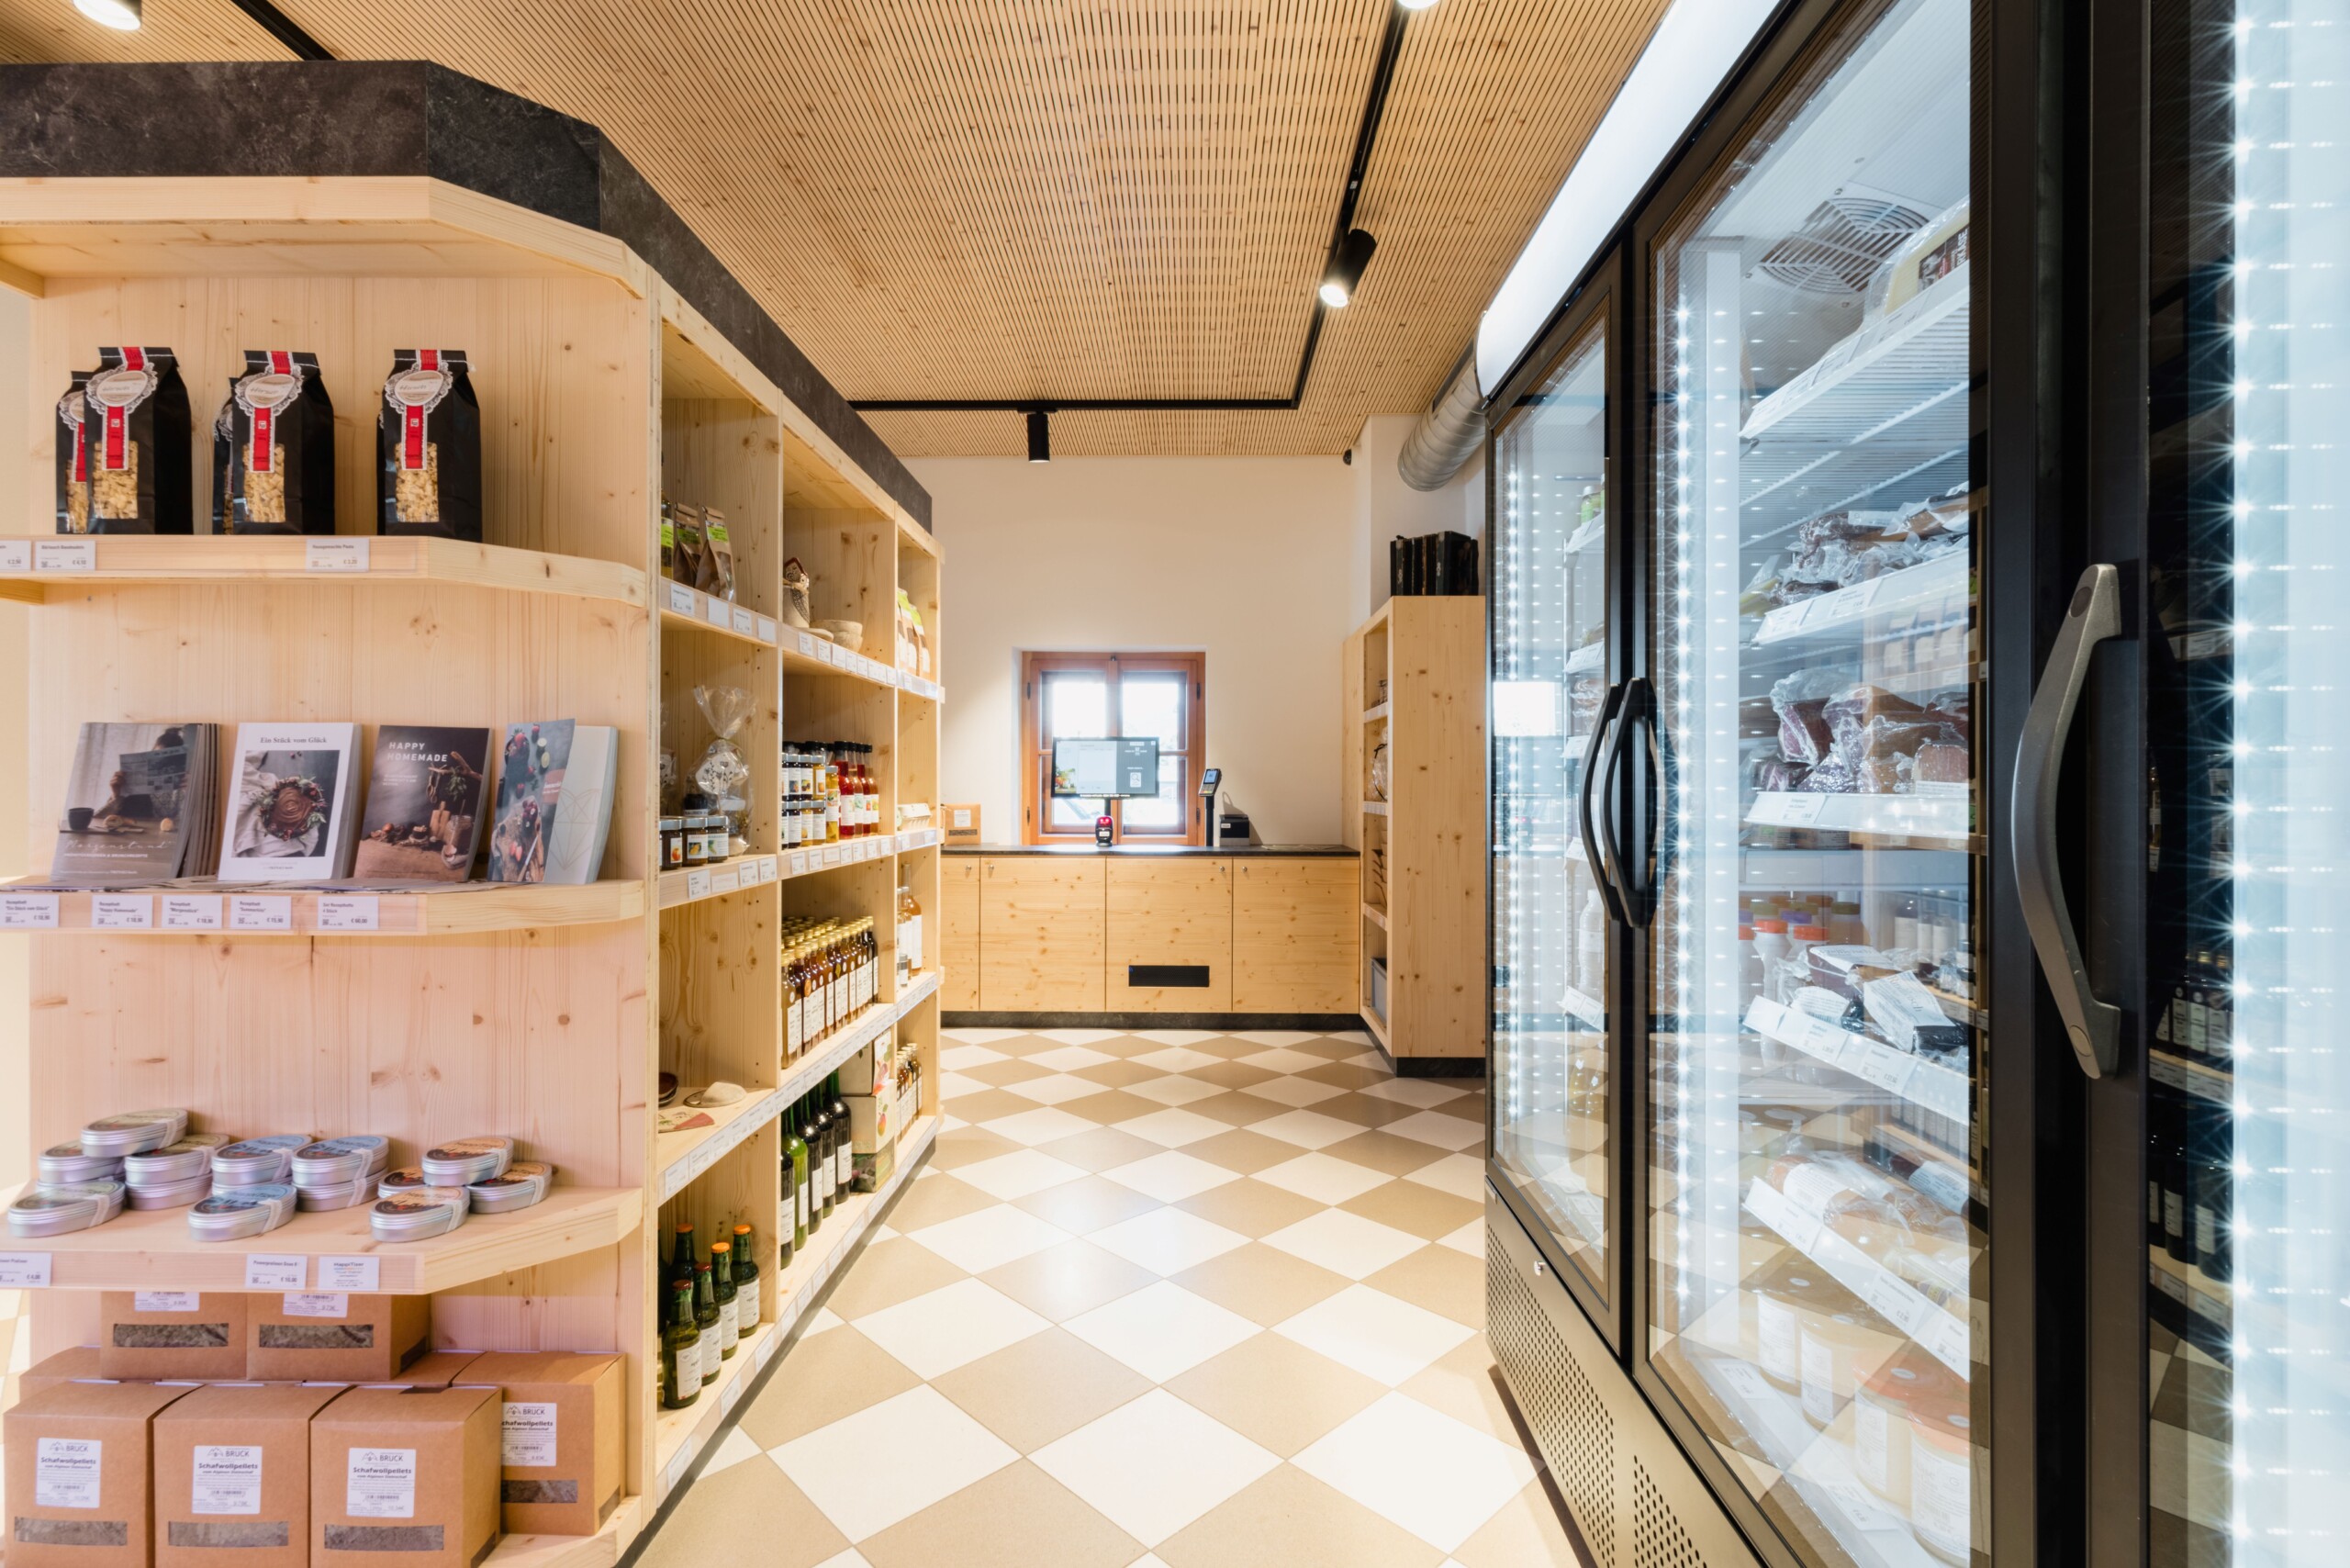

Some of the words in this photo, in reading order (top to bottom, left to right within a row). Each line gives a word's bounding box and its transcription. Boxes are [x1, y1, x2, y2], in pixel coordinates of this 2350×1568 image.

[389, 742, 426, 751] HAPPY
[386, 753, 448, 762] HOMEMADE
[40, 1457, 96, 1465] Schafwollpellets
